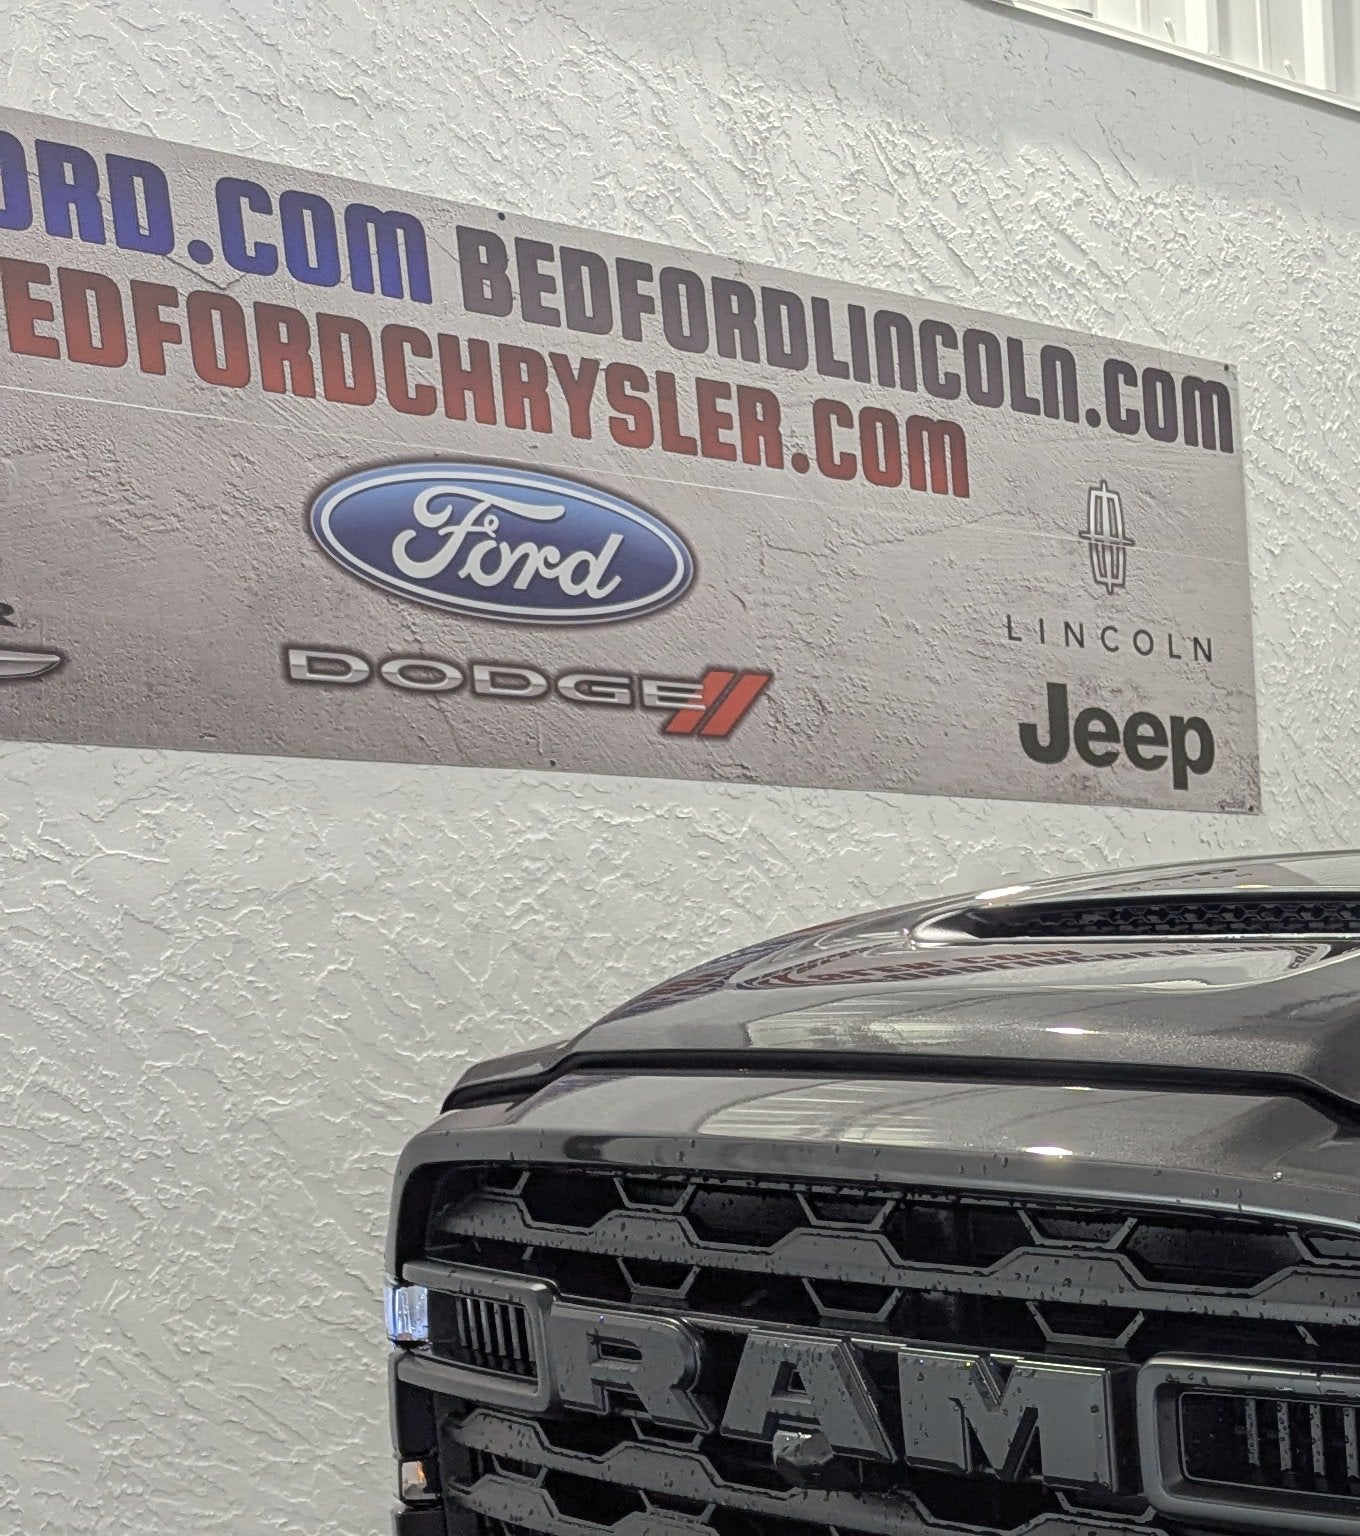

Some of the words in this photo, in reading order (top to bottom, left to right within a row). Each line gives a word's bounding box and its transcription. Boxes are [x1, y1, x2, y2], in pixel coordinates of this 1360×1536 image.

[456, 225, 1234, 454] BEDFORDLINCOLN.COM
[392, 484, 625, 600] Ford
[287, 649, 706, 712] DODGE
[1007, 614, 1213, 662] LINCOLN
[1018, 681, 1216, 791] Jeep
[549, 1301, 1118, 1493] RAM
